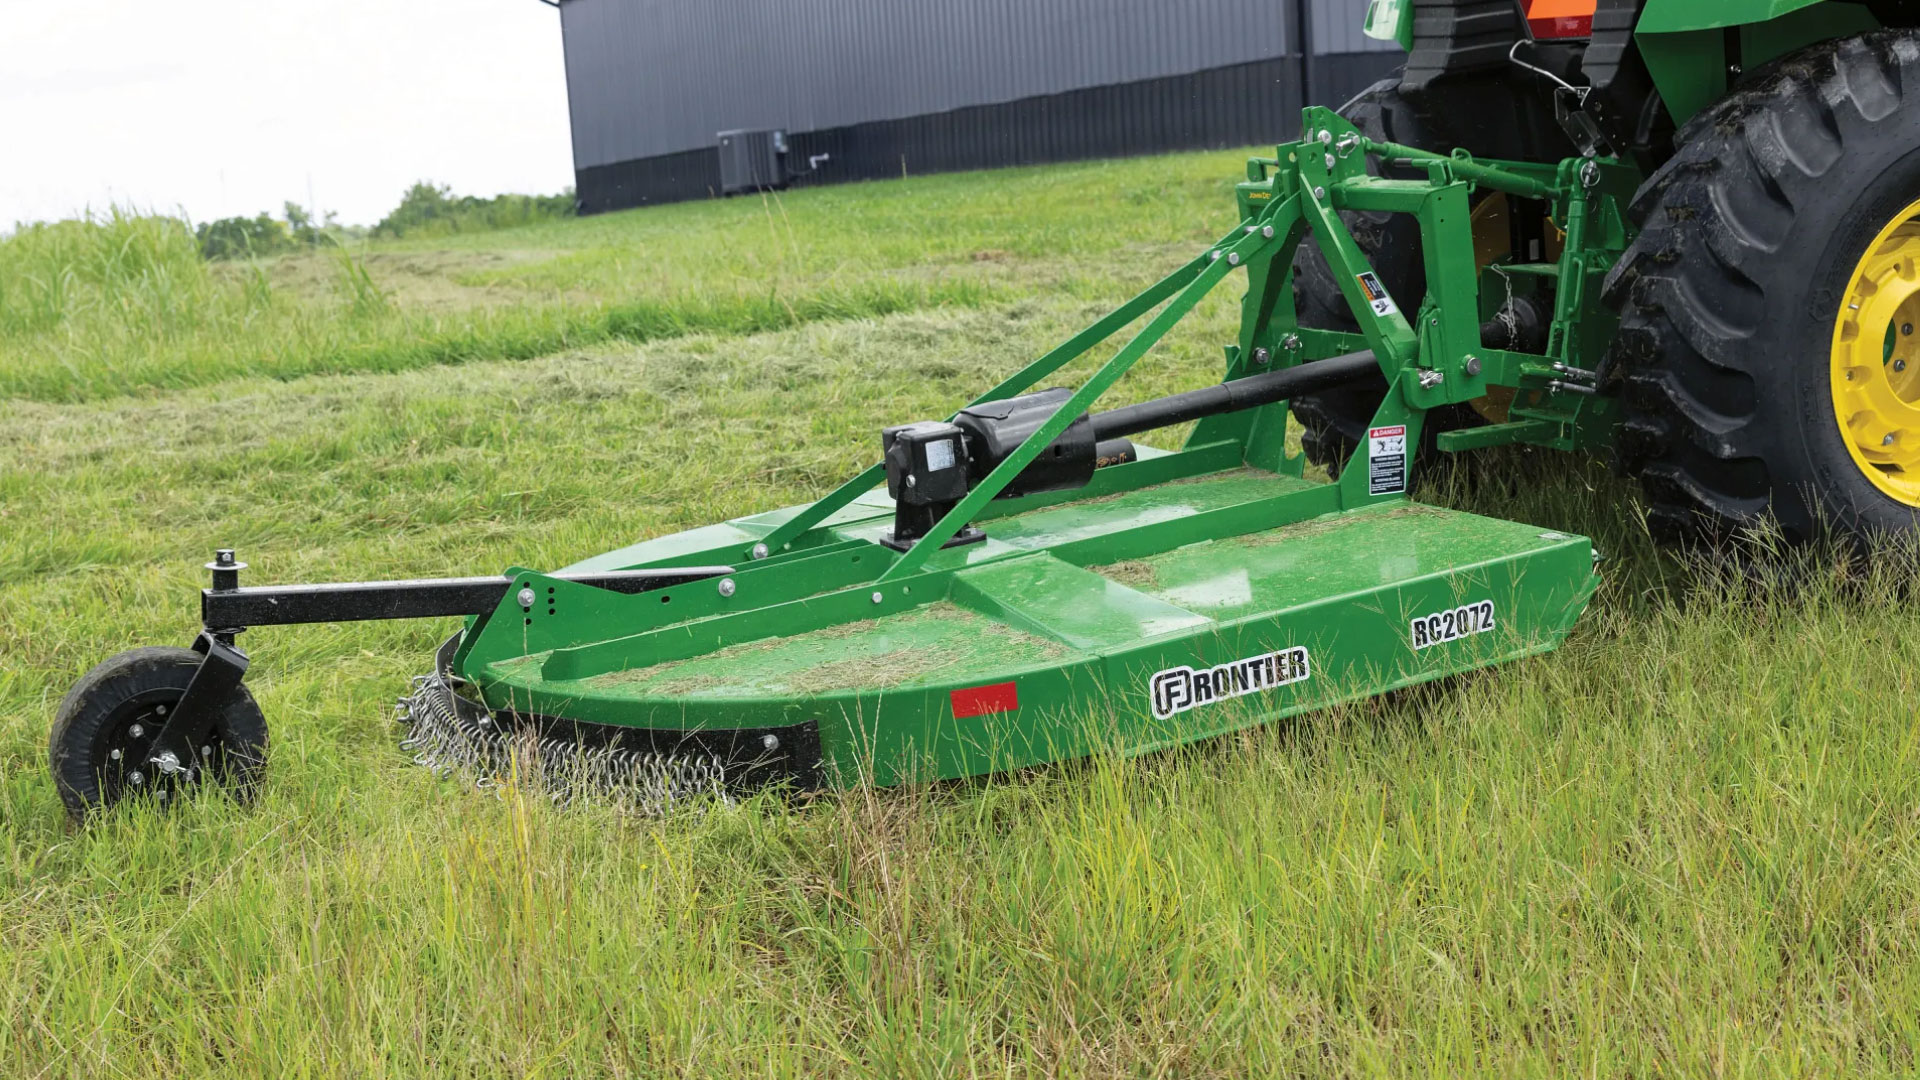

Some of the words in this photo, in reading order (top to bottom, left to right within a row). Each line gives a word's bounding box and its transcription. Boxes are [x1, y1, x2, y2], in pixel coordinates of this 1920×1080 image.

[1380, 428, 1403, 437] DANGER
[1413, 602, 1493, 647] RC2072
[1154, 649, 1307, 716] FRONTIER
